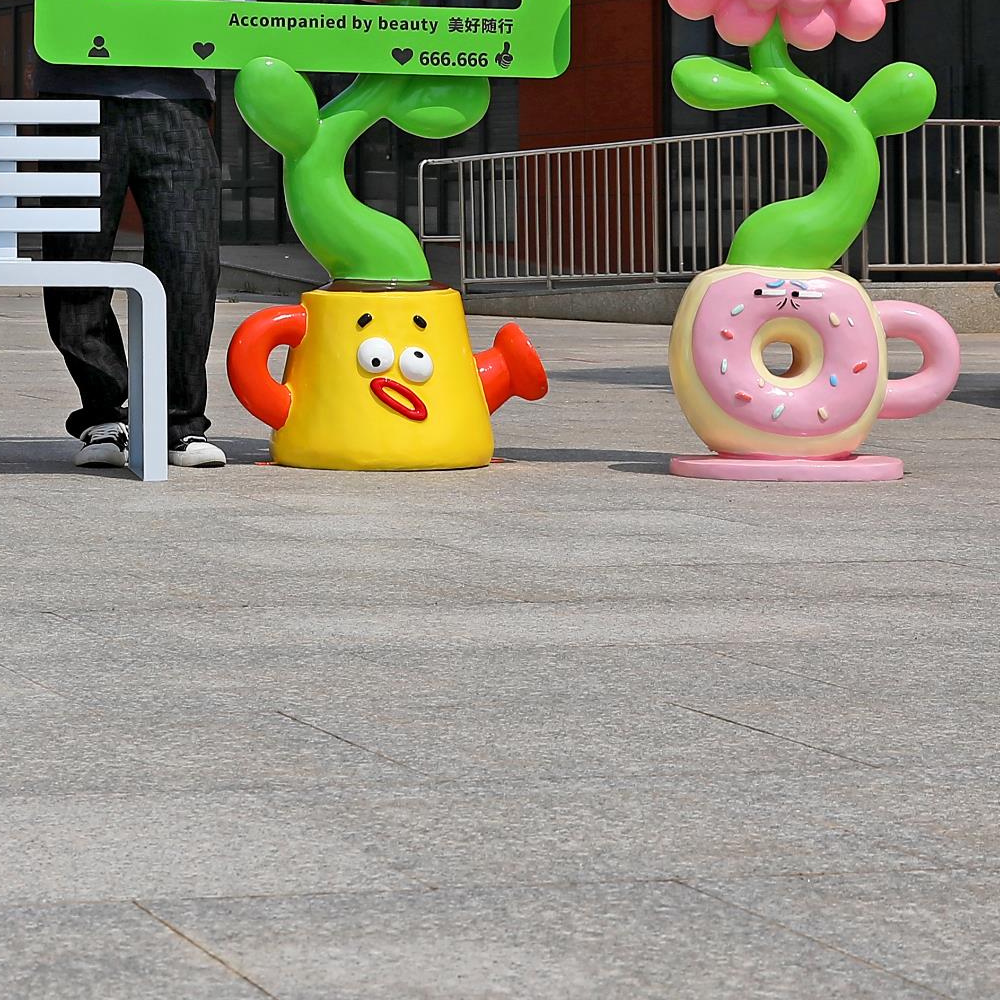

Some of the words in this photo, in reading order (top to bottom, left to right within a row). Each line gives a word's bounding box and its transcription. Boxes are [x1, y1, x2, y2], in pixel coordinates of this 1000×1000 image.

[228, 13, 347, 31] Accompanied
[352, 15, 373, 33] by
[378, 16, 439, 34] beauty
[448, 17, 514, 34] 美好随行
[419, 50, 489, 68] 666.666
